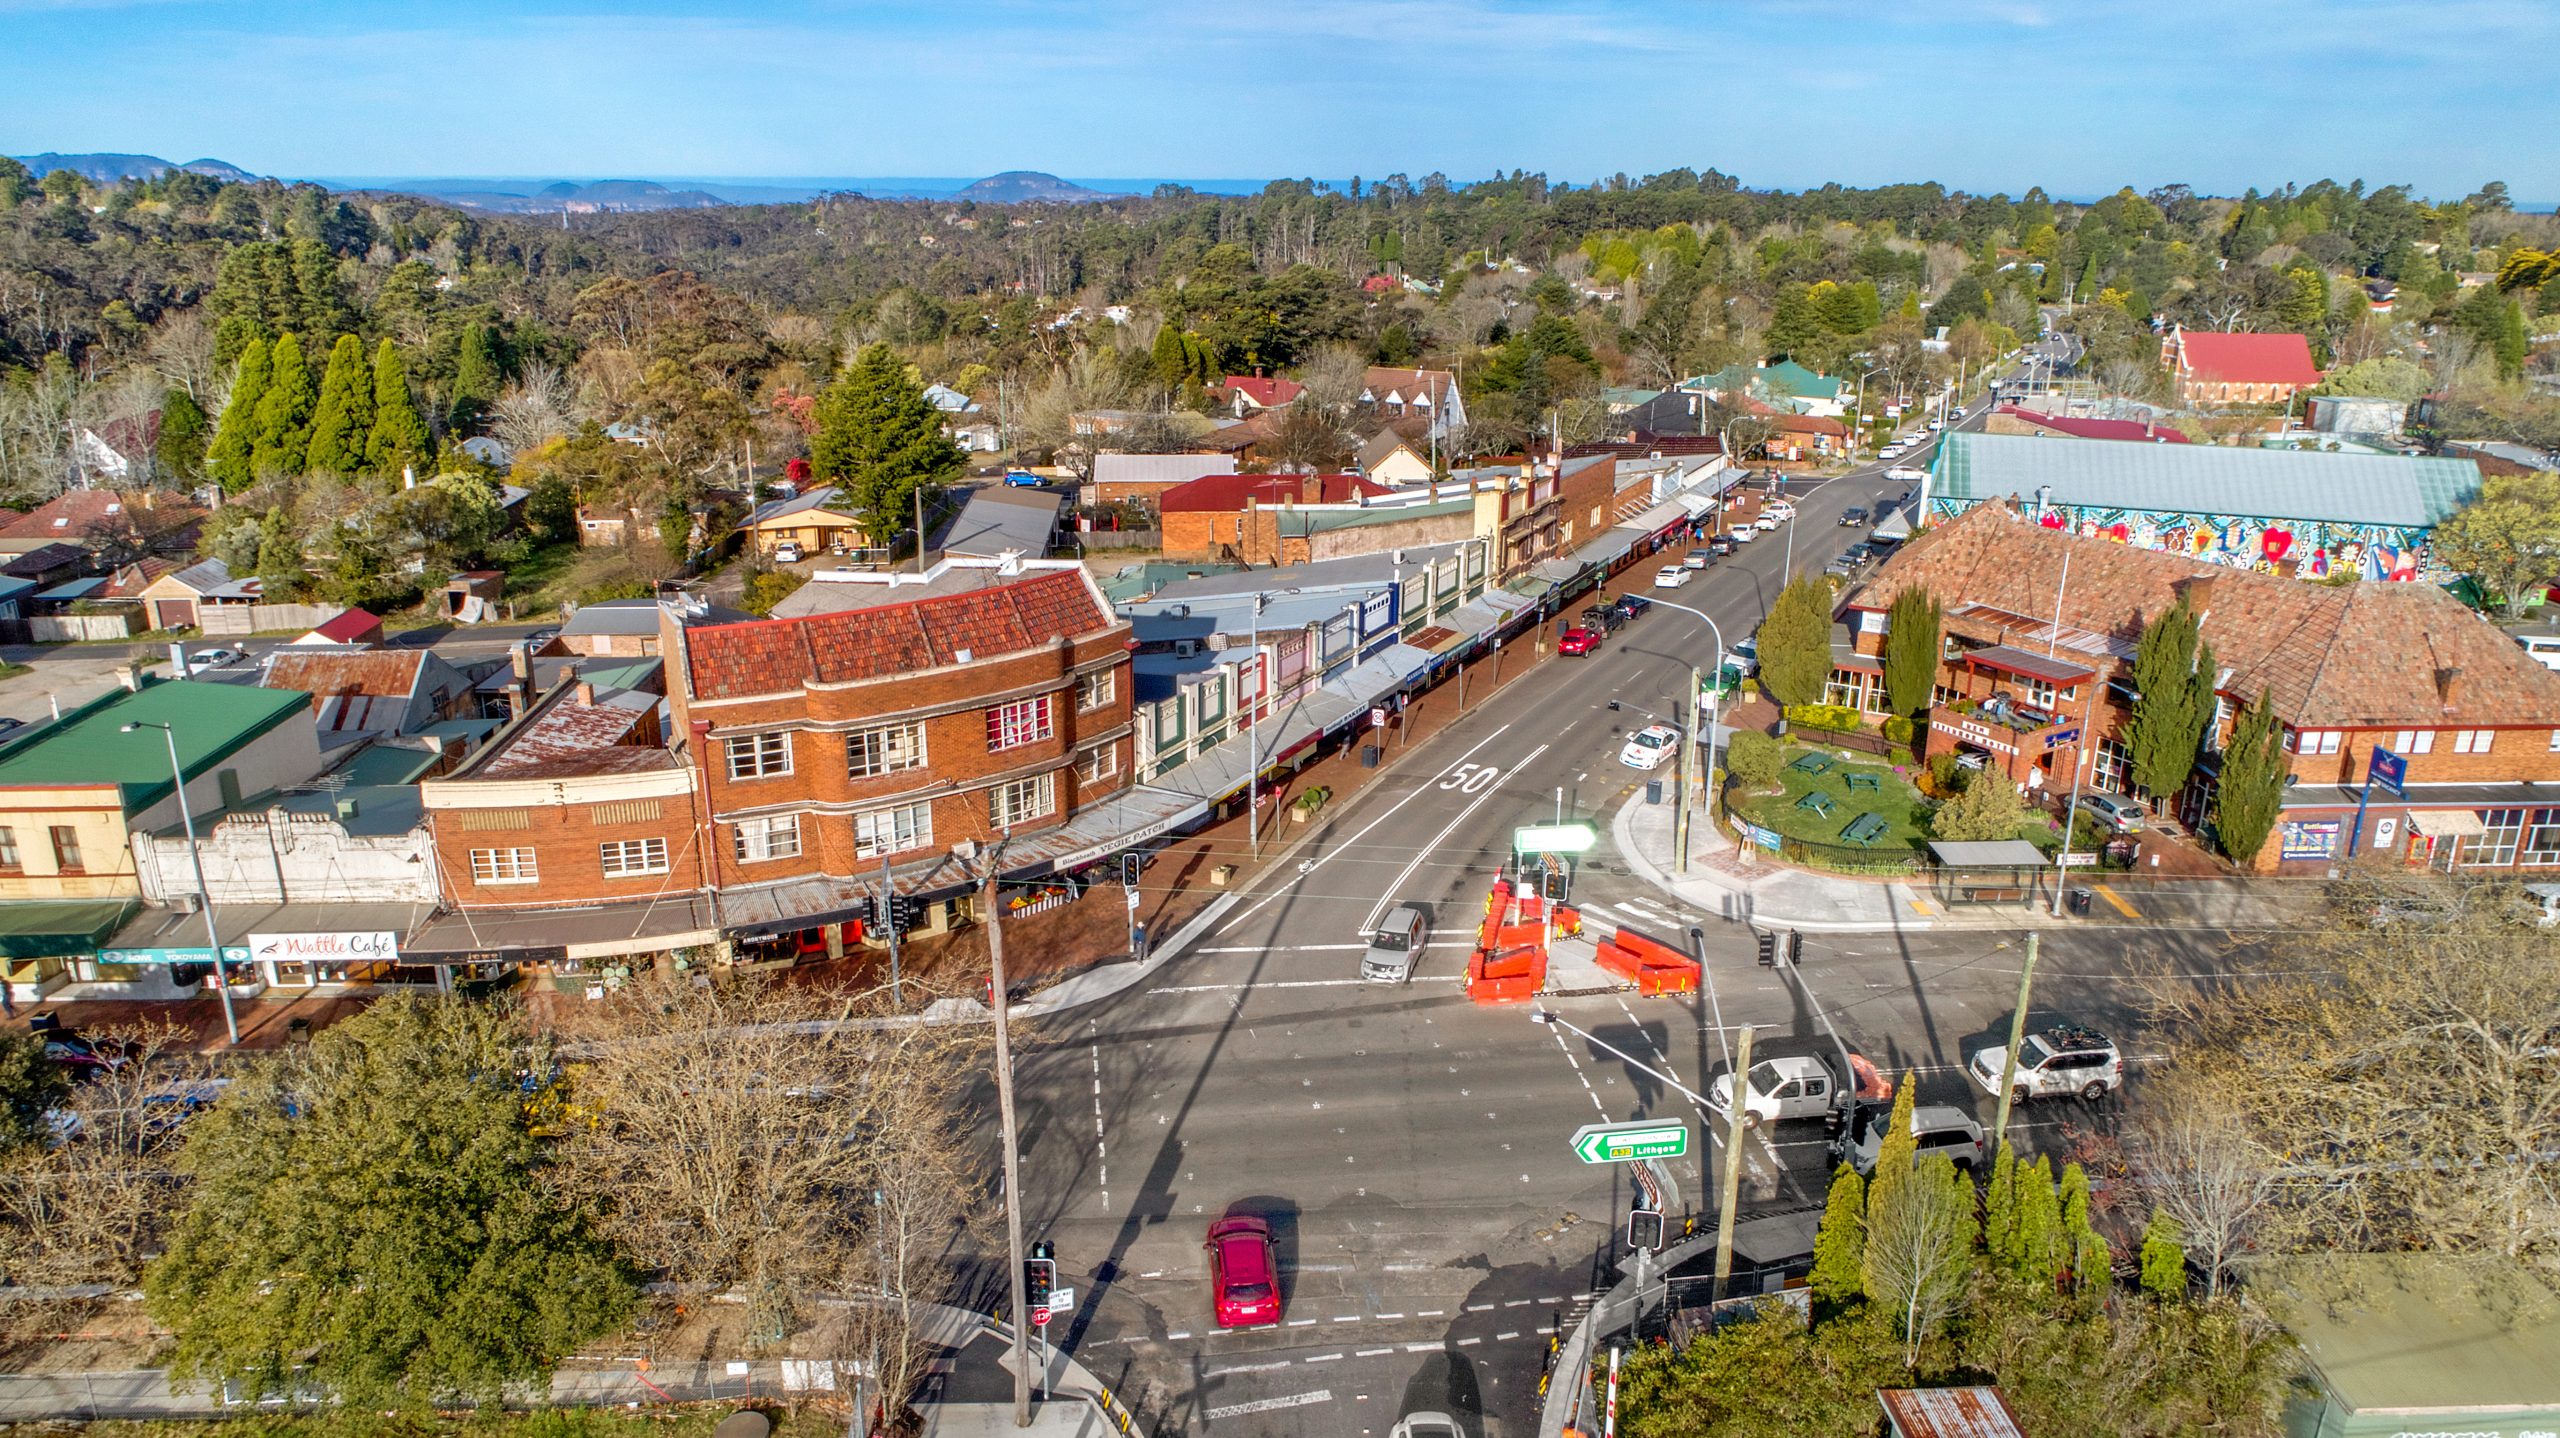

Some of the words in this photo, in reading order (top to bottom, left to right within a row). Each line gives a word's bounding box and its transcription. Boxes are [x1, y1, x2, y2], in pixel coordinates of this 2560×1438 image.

[1966, 723, 1985, 734] NEW
[1439, 763, 1509, 793] 50
[1062, 851, 1096, 865] Blackheath
[1100, 837, 1132, 852] VEGIE
[1133, 822, 1165, 841] PATCH
[743, 934, 778, 944] ANONYMOUS
[286, 934, 348, 955] Wattle
[350, 933, 392, 957] Café
[1636, 1145, 1677, 1156] Lithgow
[1033, 1312, 1051, 1322] STOP
